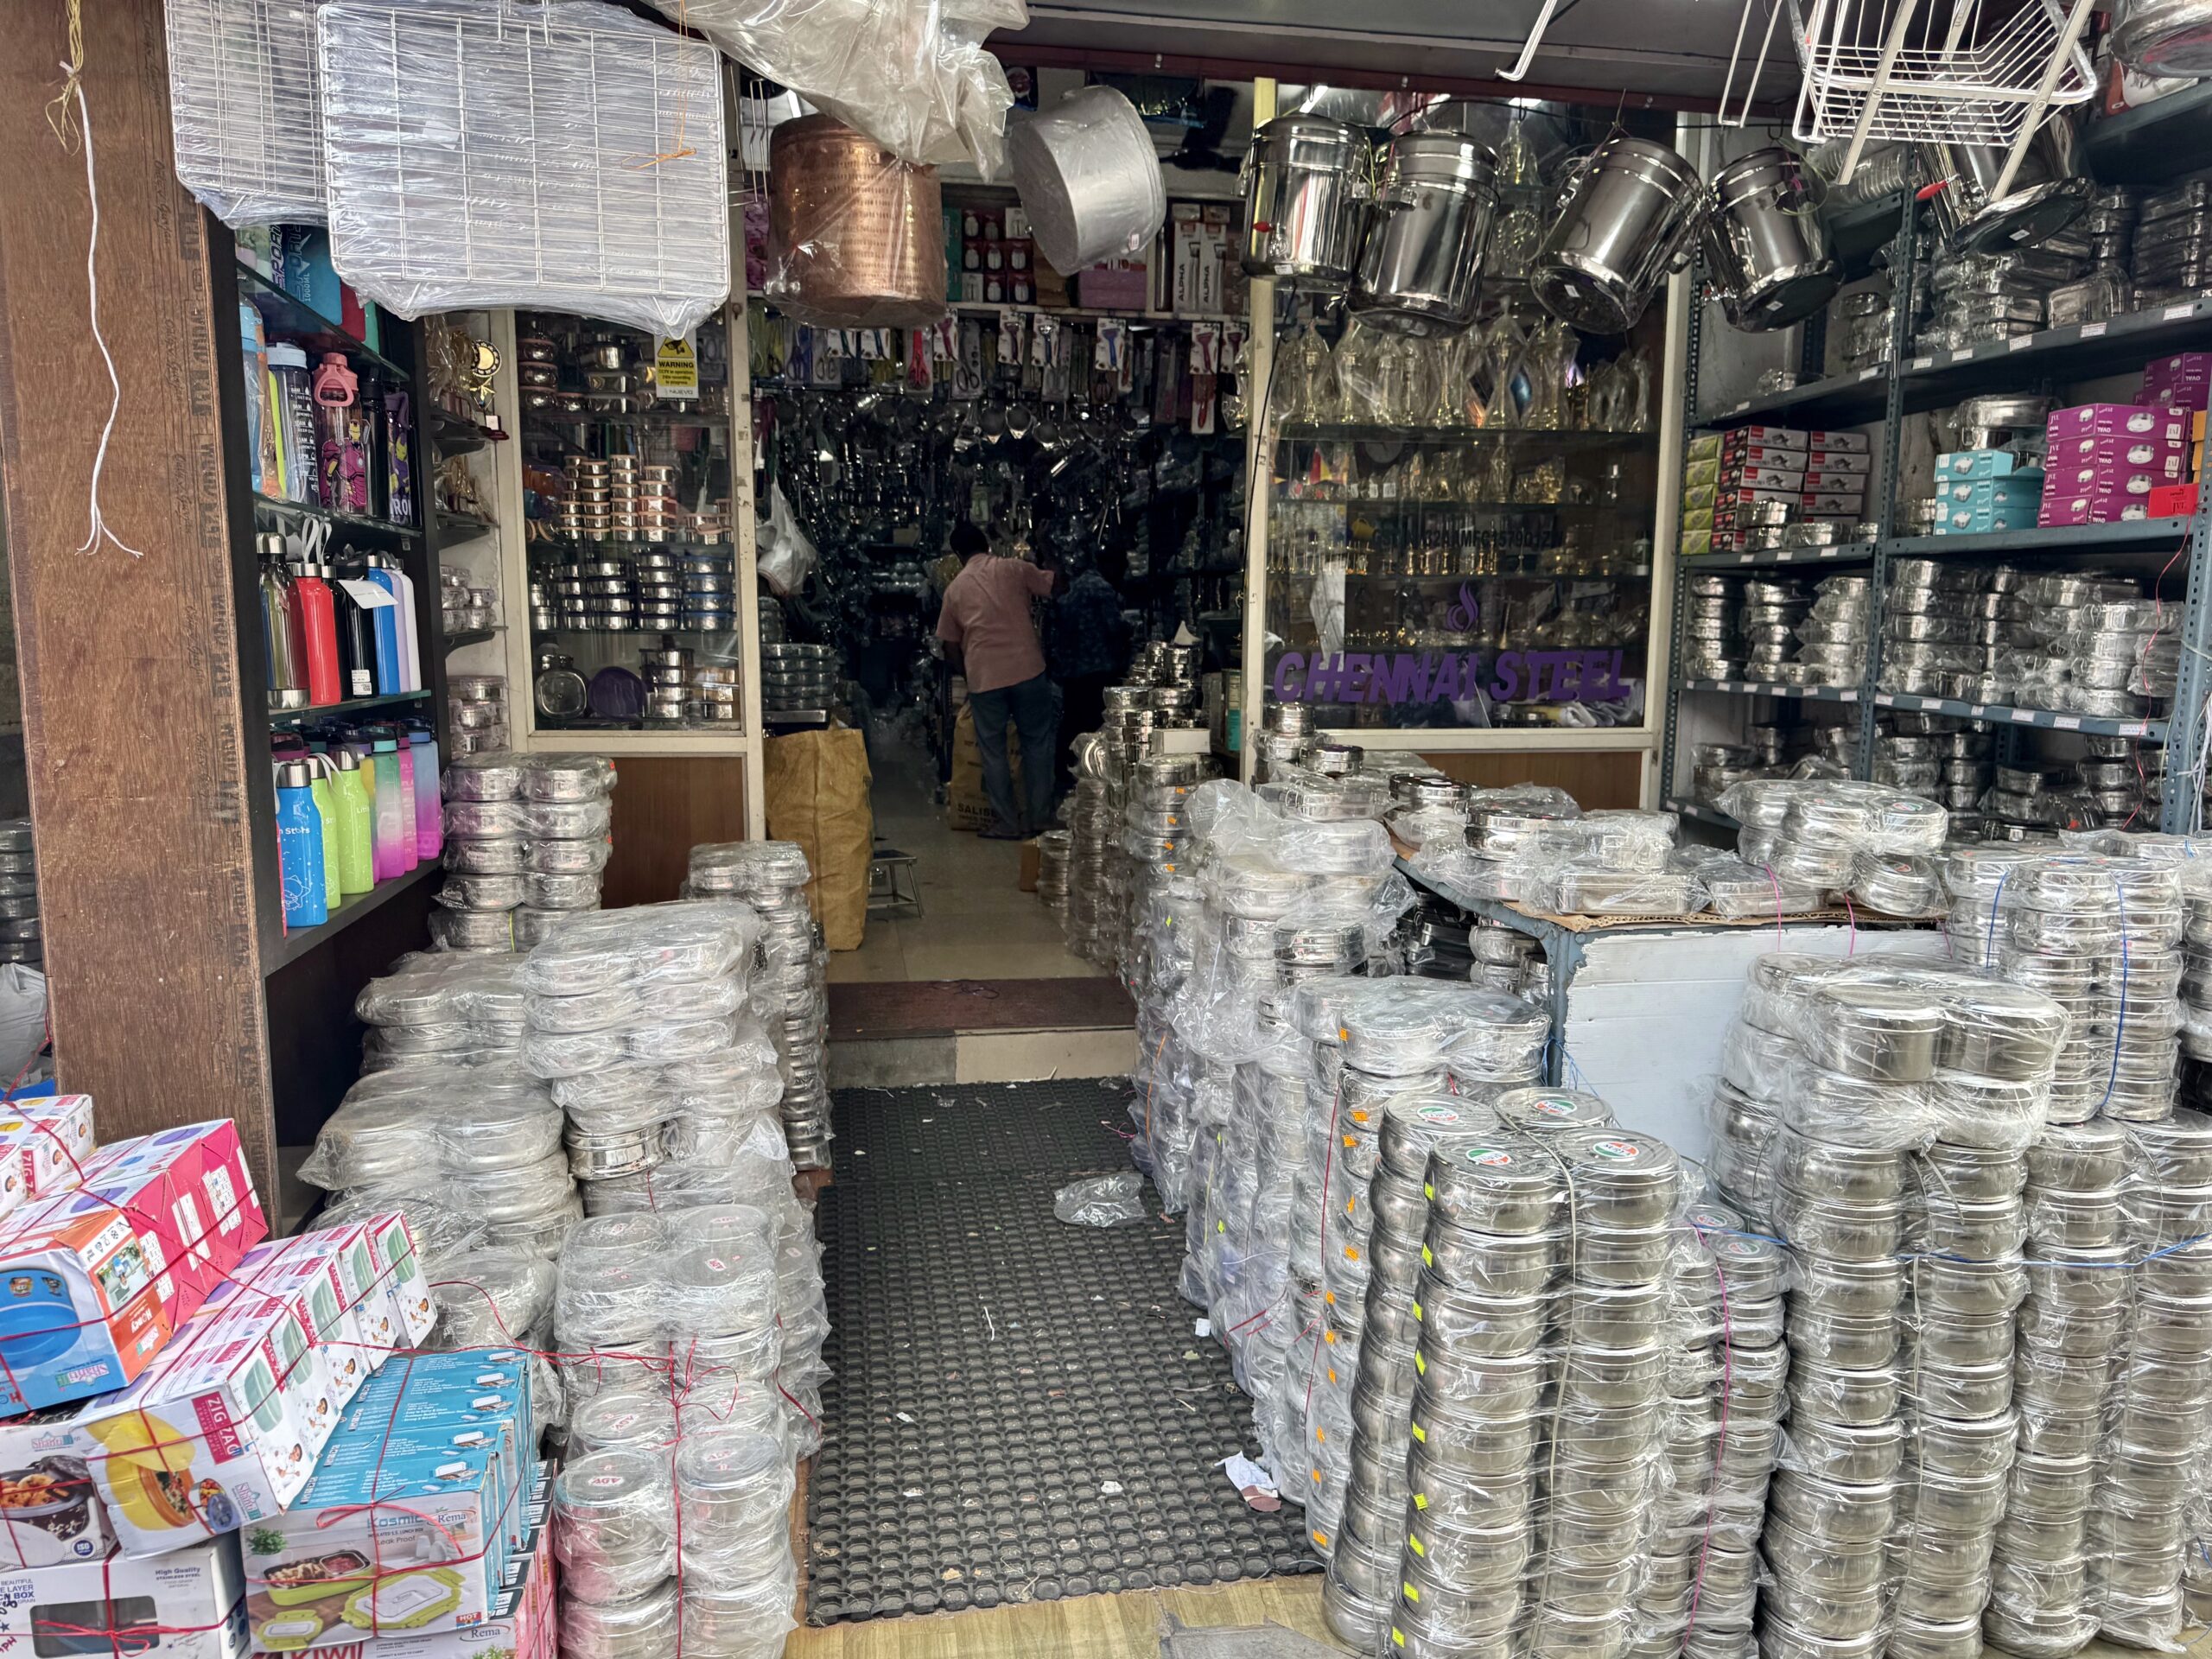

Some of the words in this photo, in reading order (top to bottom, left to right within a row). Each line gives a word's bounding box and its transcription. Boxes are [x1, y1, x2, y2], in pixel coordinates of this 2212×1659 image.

[391, 499, 410, 517] IRO
[1274, 652, 1478, 702] CHENNAI
[1491, 650, 1630, 701] STEEL
[207, 1397, 227, 1422] ZIG
[366, 1515, 424, 1529] Kosmic
[437, 1513, 467, 1523] Rema
[76, 1542, 90, 1551] ISO
[13, 1591, 35, 1599] BOX
[459, 1612, 478, 1621] HOT
[471, 1627, 501, 1637] Rema
